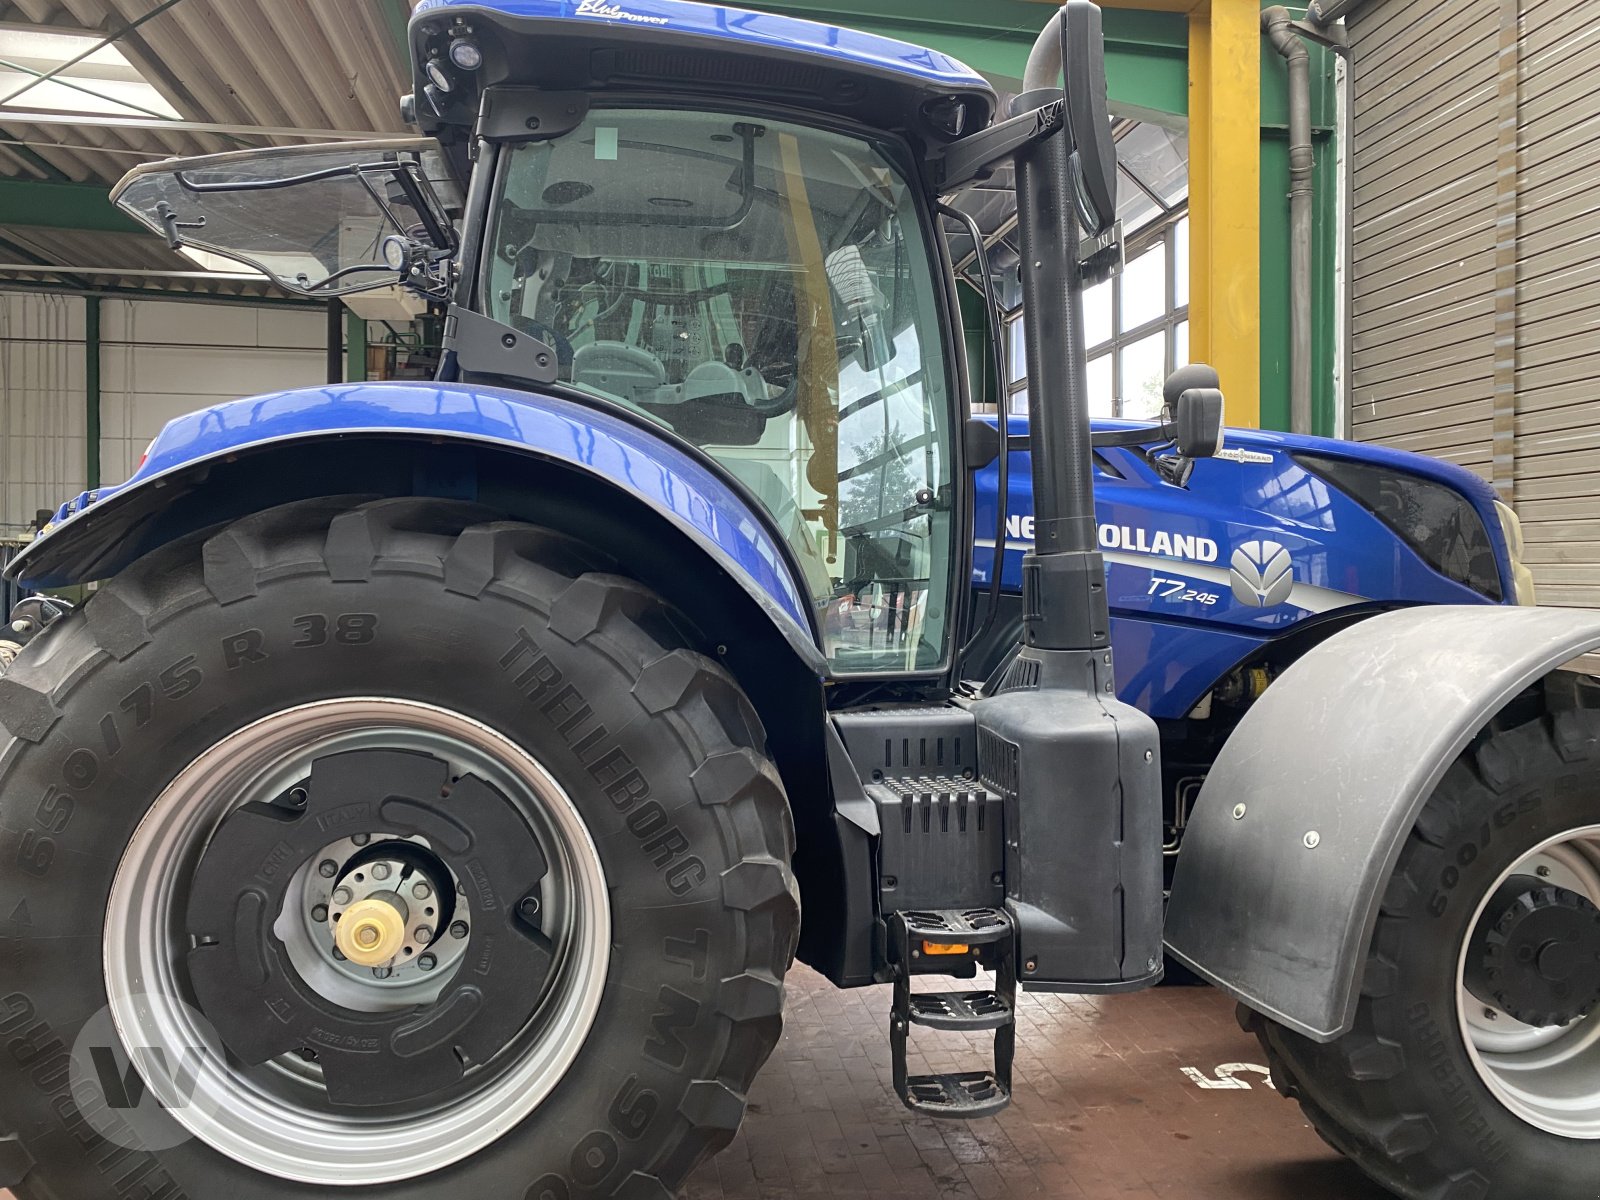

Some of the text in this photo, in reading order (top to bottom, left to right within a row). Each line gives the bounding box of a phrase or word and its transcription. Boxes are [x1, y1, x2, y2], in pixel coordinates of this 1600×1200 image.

[1004, 514, 1218, 563] NE OLLAND
[1147, 577, 1220, 606] T7.245
[17, 654, 205, 879] 650/75
[221, 626, 271, 671] R
[291, 612, 380, 649] 38
[497, 625, 708, 899] TRELLEBORG
